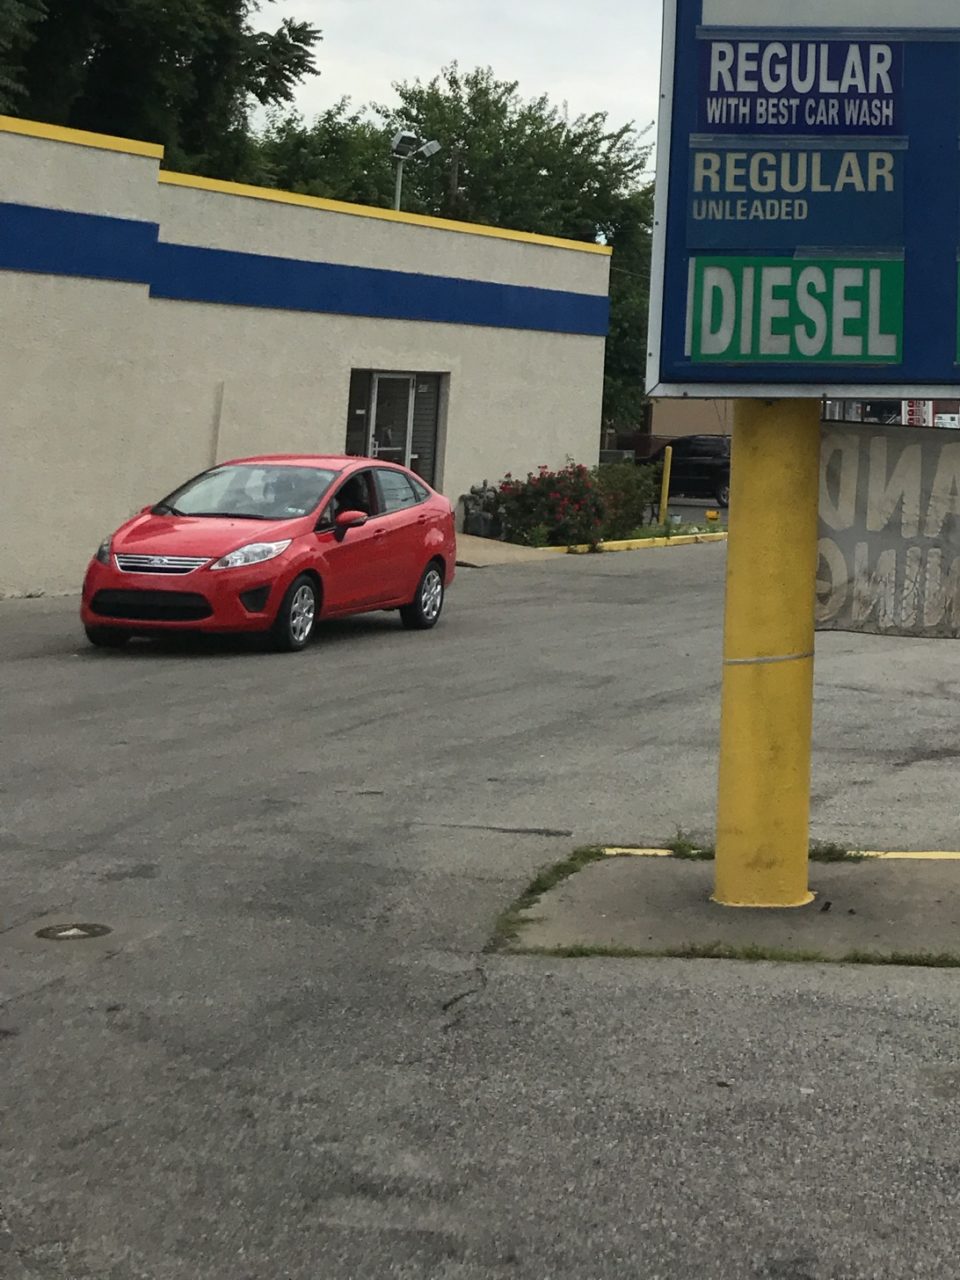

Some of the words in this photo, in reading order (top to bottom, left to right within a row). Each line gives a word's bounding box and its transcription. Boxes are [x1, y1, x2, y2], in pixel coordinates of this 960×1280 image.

[709, 42, 893, 93] REGULAR
[706, 98, 750, 125] WITH
[755, 99, 800, 125] BEST
[804, 99, 839, 125] CAR
[844, 99, 893, 126] WASH
[693, 152, 894, 192] REGULAR
[692, 200, 808, 220] UNLEADED
[701, 266, 897, 357] DIESEL
